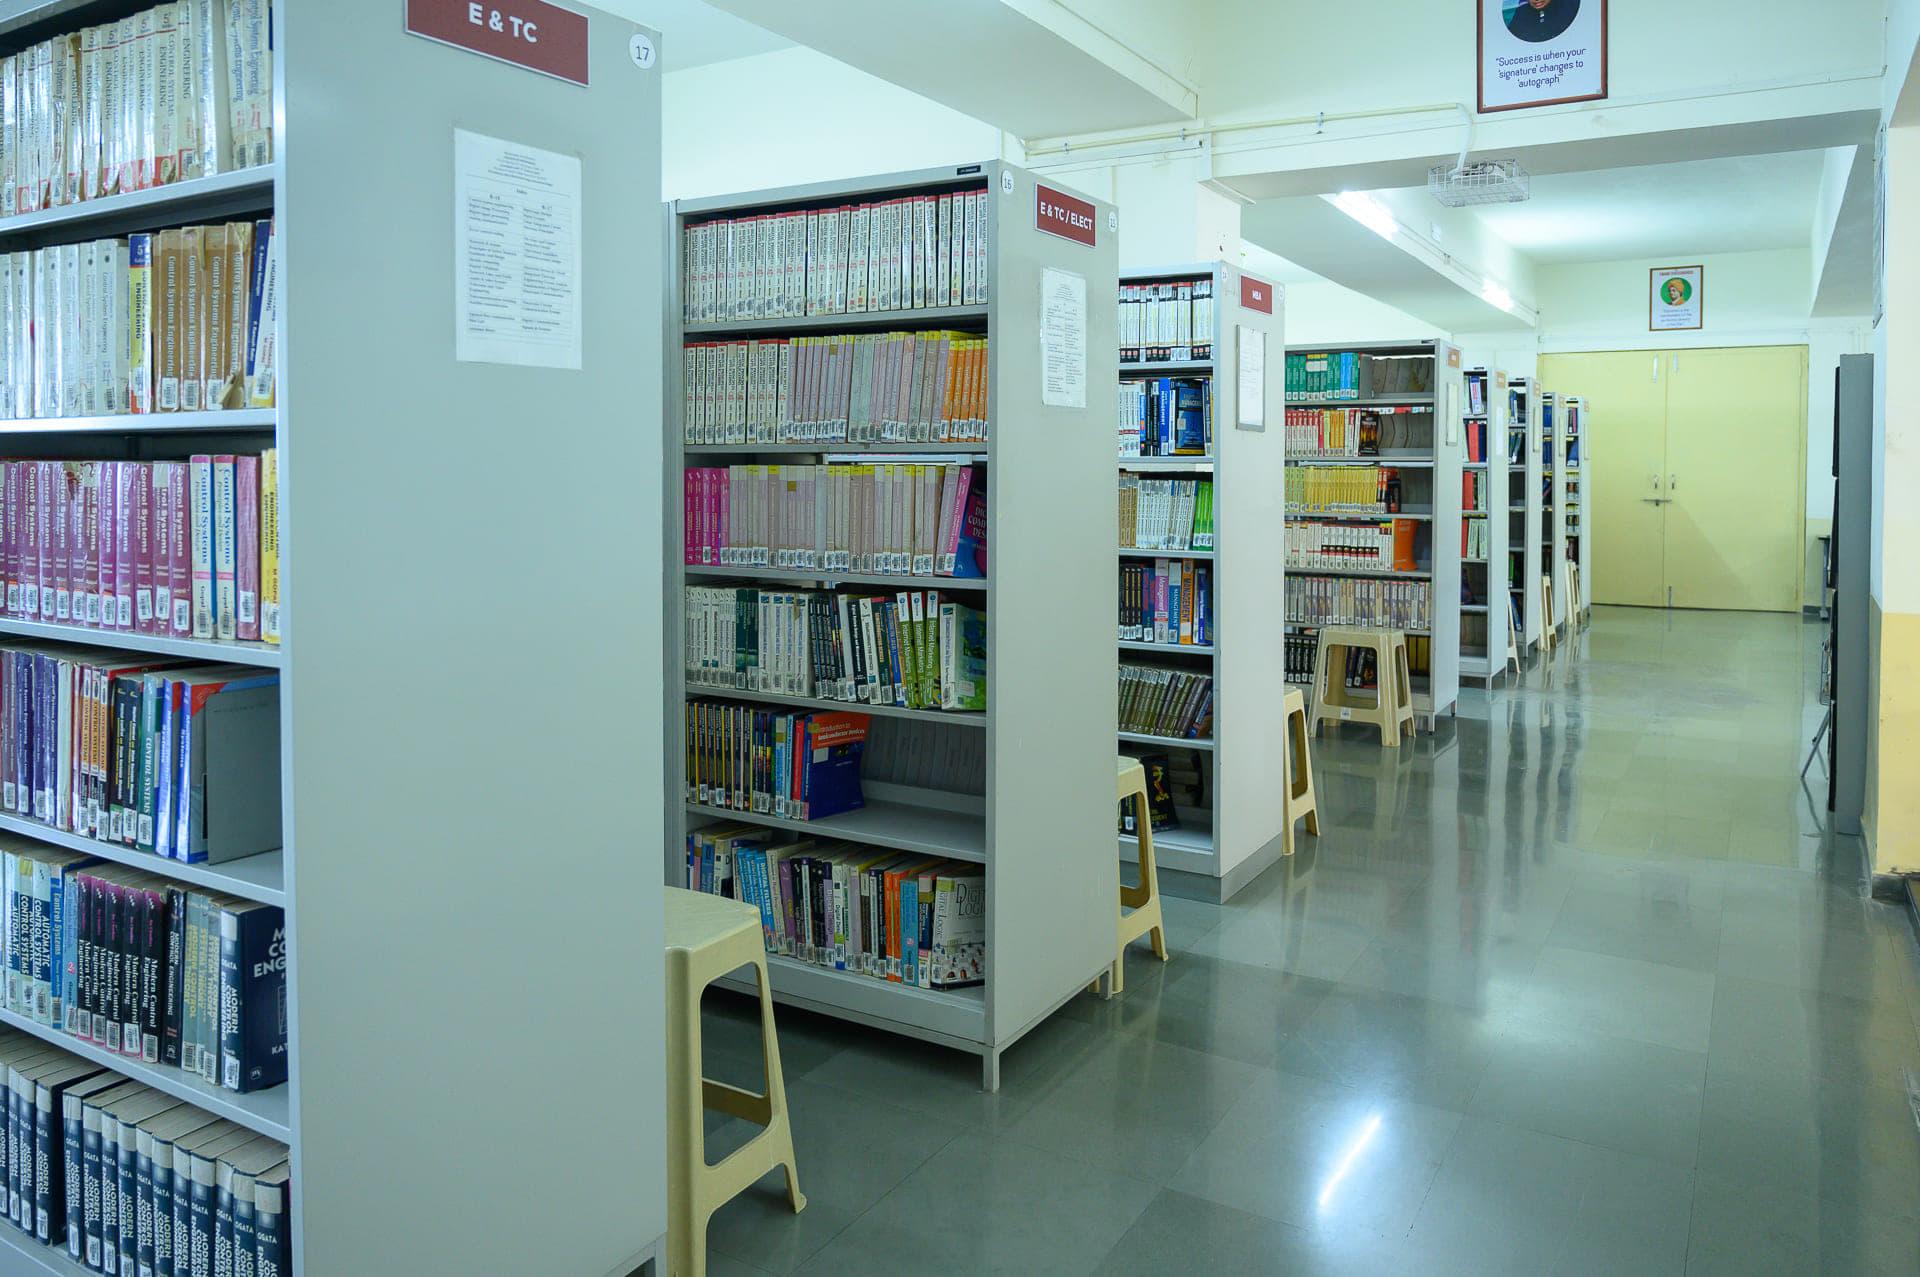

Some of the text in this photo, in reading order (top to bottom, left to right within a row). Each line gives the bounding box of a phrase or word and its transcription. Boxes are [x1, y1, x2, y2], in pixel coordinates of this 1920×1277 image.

[469, 2, 537, 43] E & TC
[160, 46, 168, 107] ENGINEERING
[183, 38, 191, 99] ENGINEERING
[247, 51, 262, 95] Engineering
[636, 46, 650, 61] 17
[1540, 61, 1574, 74] changes
[1576, 60, 1584, 68] to
[1543, 50, 1565, 60] when
[1566, 48, 1586, 60] your
[1040, 202, 1046, 215] E
[1047, 204, 1053, 217] &
[1055, 206, 1065, 222] TC
[1070, 210, 1093, 232] ELECT
[188, 255, 198, 322] Control Systems
[232, 251, 243, 320] Control Systems
[166, 256, 178, 377] Control Systems Engineering
[209, 256, 222, 378] Control Systems Engineering
[176, 510, 184, 557] Systems
[200, 469, 210, 564] Control Systems
[222, 469, 232, 564] Control Systems
[1157, 576, 1166, 610] Management
[1182, 578, 1192, 622] MANAGEMENT
[928, 620, 936, 642] Internet
[903, 646, 911, 674] Marketing
[926, 643, 935, 668] Marketing
[144, 738, 152, 814] CONTROL SYSTEMS
[760, 862, 772, 915] DIGITAL FILTERS
[12, 906, 20, 957] AUTOMATIC
[21, 896, 30, 975] CONTROL SYSTEMS
[34, 900, 42, 941] CONTROL
[42, 916, 50, 967] AUTOMATIC
[53, 892, 62, 956] Control Systems
[106, 950, 114, 1001] Engineering
[124, 954, 132, 1004] Engineering
[142, 956, 150, 1008] Engineering
[190, 972, 198, 1018] CONTROL
[150, 994, 158, 1028] Control
[231, 987, 239, 1033] MODERN
[126, 1194, 134, 1238] MODERN
[164, 1214, 172, 1258] MODERN
